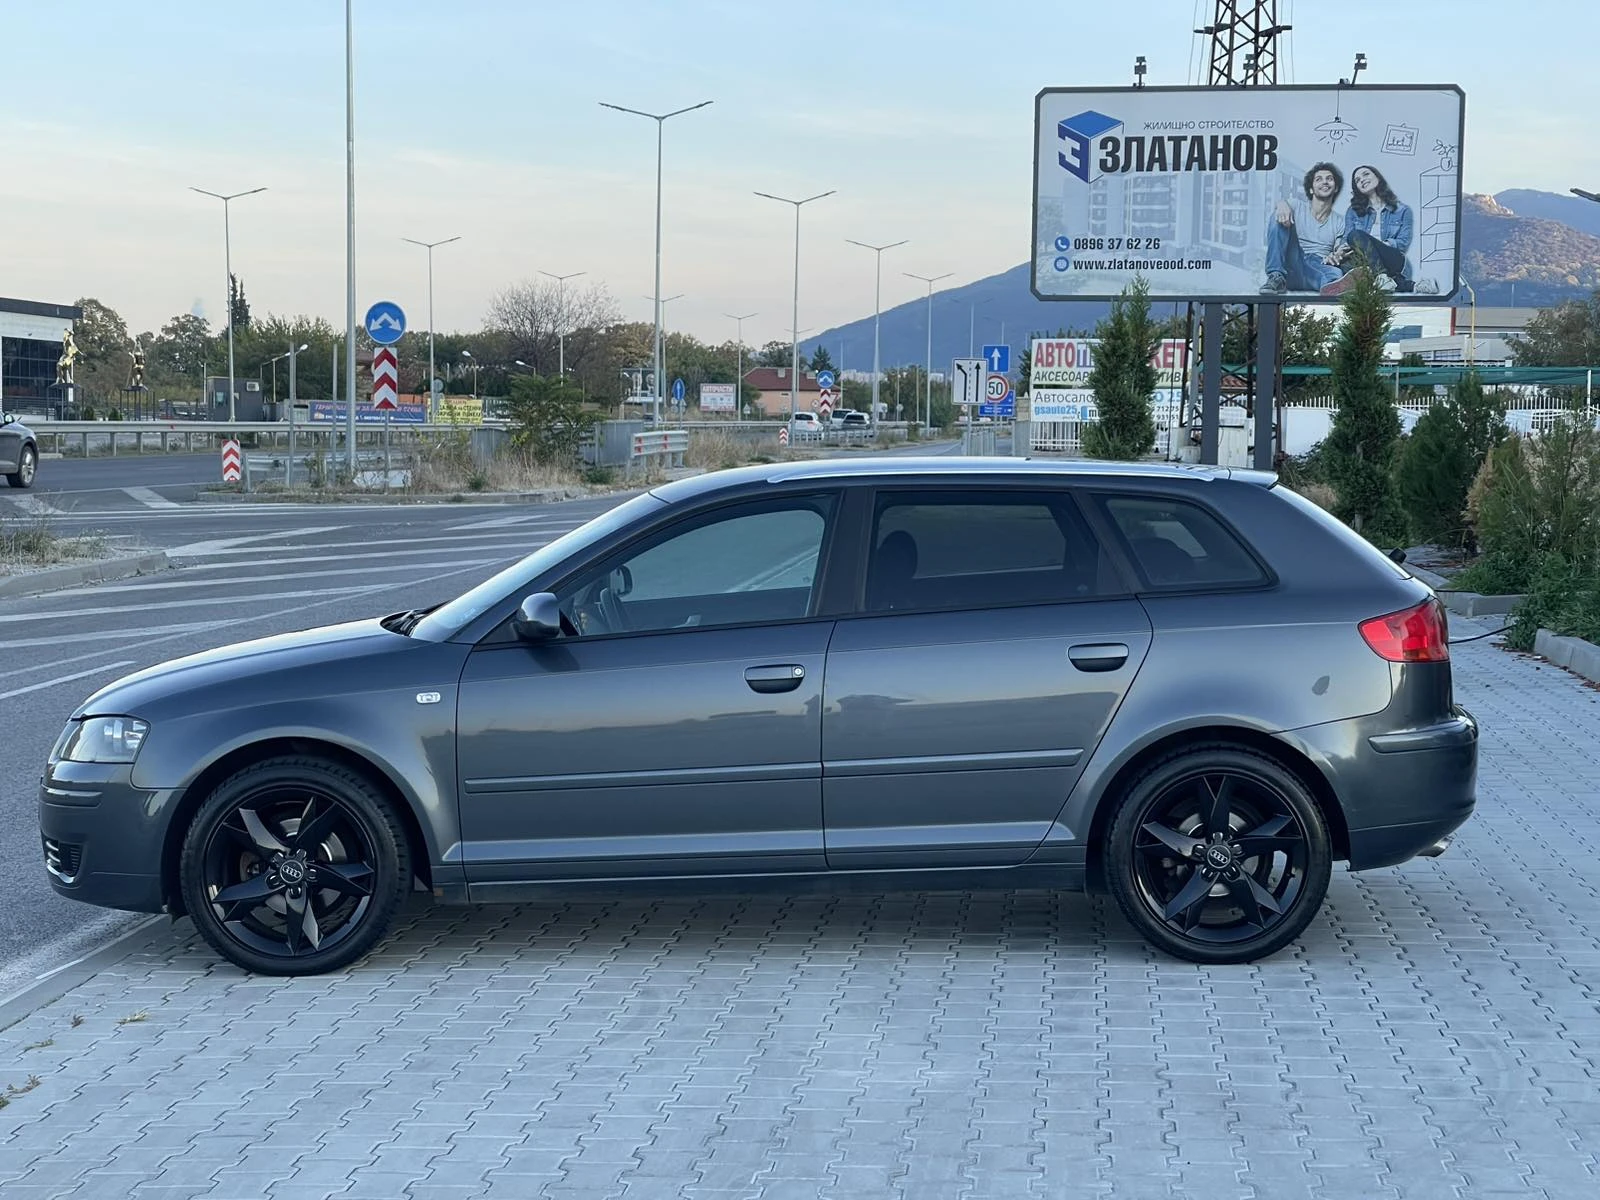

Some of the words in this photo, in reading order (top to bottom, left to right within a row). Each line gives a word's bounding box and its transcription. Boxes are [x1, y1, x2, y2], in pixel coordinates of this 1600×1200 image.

[1143, 121, 1196, 130] ЖИЛИЩНО
[1198, 120, 1274, 129] СТРОИТЕЛСТВО
[1099, 134, 1278, 173] ЗЛАТАНОВ
[1073, 237, 1104, 250] 0896
[1107, 237, 1123, 250] 37
[1126, 237, 1142, 250] 62
[1145, 237, 1161, 250] 26
[1073, 257, 1212, 270] www.zlatanoveood.com
[1033, 371, 1090, 382] АКСЕСОАР
[987, 381, 1003, 396] 50
[1034, 391, 1097, 403] Автосало
